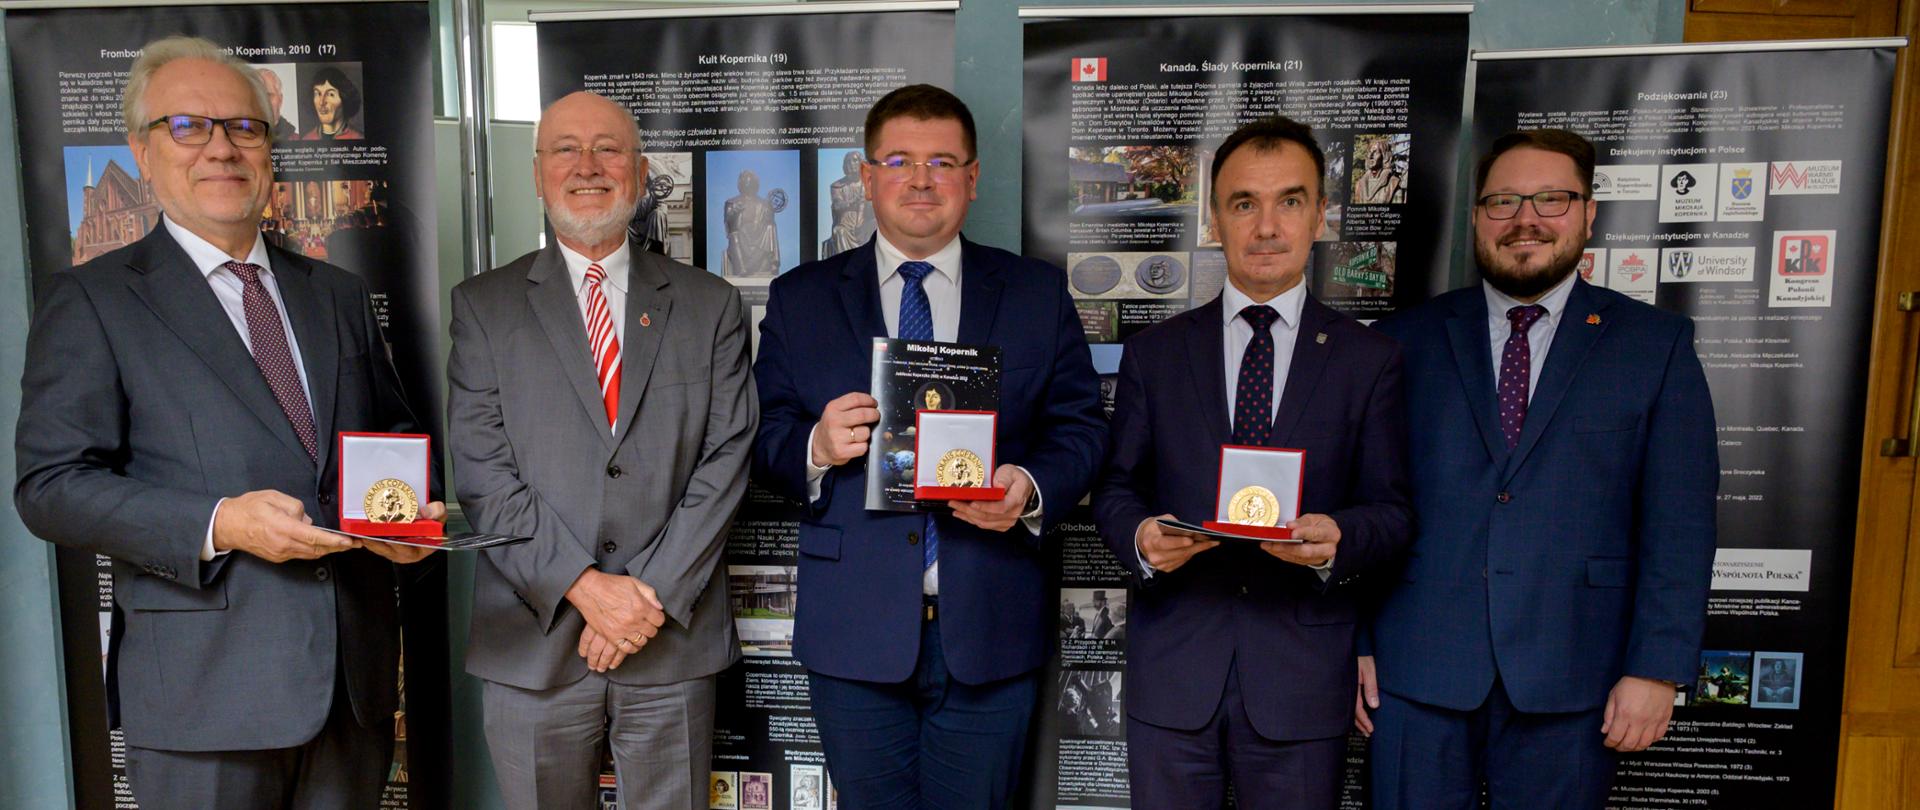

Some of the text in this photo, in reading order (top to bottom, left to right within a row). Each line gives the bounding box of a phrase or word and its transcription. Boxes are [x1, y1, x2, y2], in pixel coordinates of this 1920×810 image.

[236, 45, 286, 57] Kopernika,
[289, 44, 310, 54] 2010
[318, 44, 336, 55] (17)
[699, 53, 788, 65] Kult Kopernika (19)
[1160, 60, 1303, 73] Kanada. Ślady Kopernika (21)
[1638, 91, 1728, 102] Podziękowania (23)
[685, 136, 720, 146] naukowców
[758, 135, 779, 144] twórca
[780, 134, 821, 145] nowoczesnej
[1610, 148, 1657, 157] Dziękujemy
[1658, 146, 1707, 156] instytucjom
[1606, 232, 1650, 242] Dziękujemy
[1652, 231, 1702, 241] instytucjom
[1712, 231, 1749, 240] Kanadzie
[1698, 256, 1747, 267] University
[1706, 266, 1746, 276] Windsor
[907, 344, 978, 356] Mikołaj Kopernik
[1060, 523, 1098, 533] Obchod
